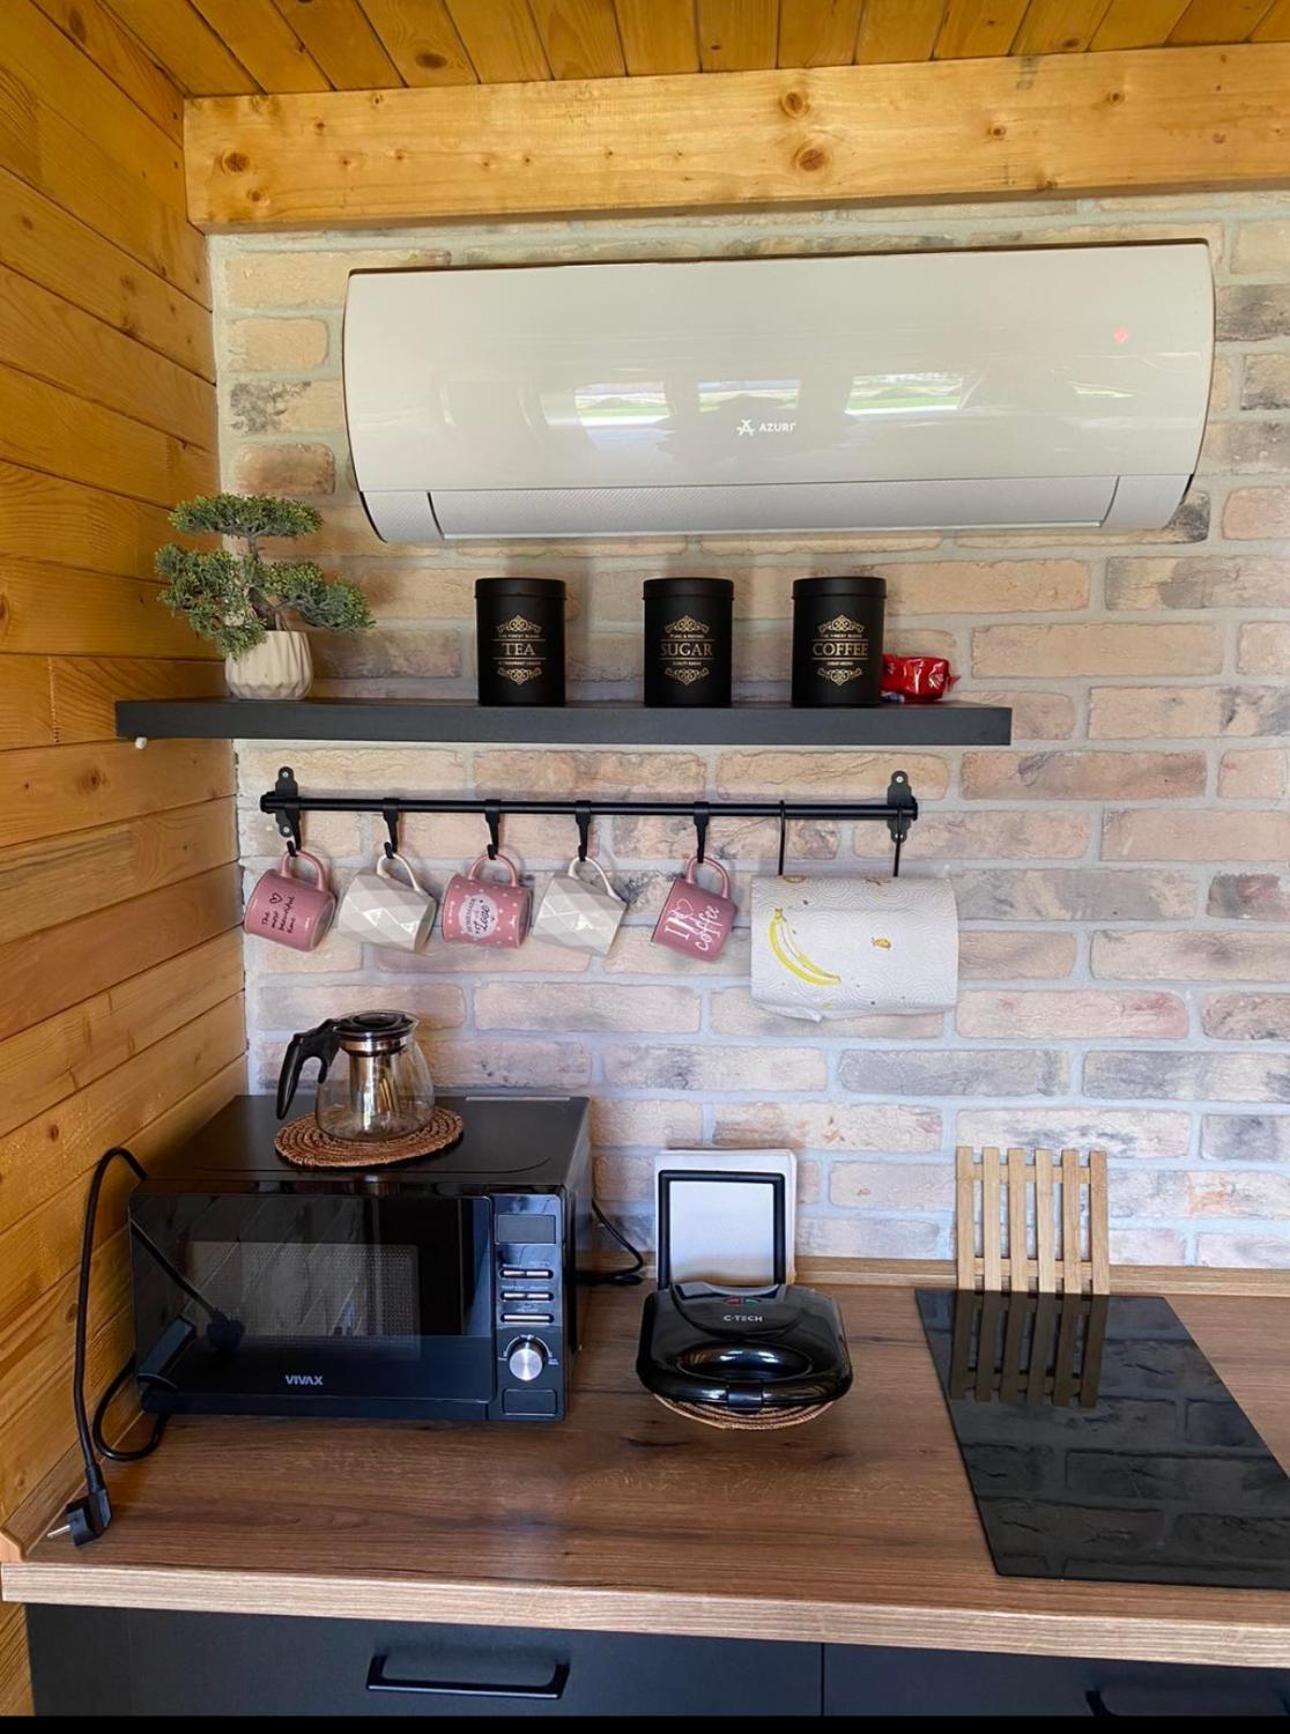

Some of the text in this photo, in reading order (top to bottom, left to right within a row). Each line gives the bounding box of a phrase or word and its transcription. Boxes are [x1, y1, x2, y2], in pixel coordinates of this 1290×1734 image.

[502, 642, 536, 656] TEA
[660, 642, 712, 656] SUGAR
[812, 642, 869, 656] COFFEE
[694, 905, 724, 952] coffee
[285, 1374, 324, 1386] VIVAX
